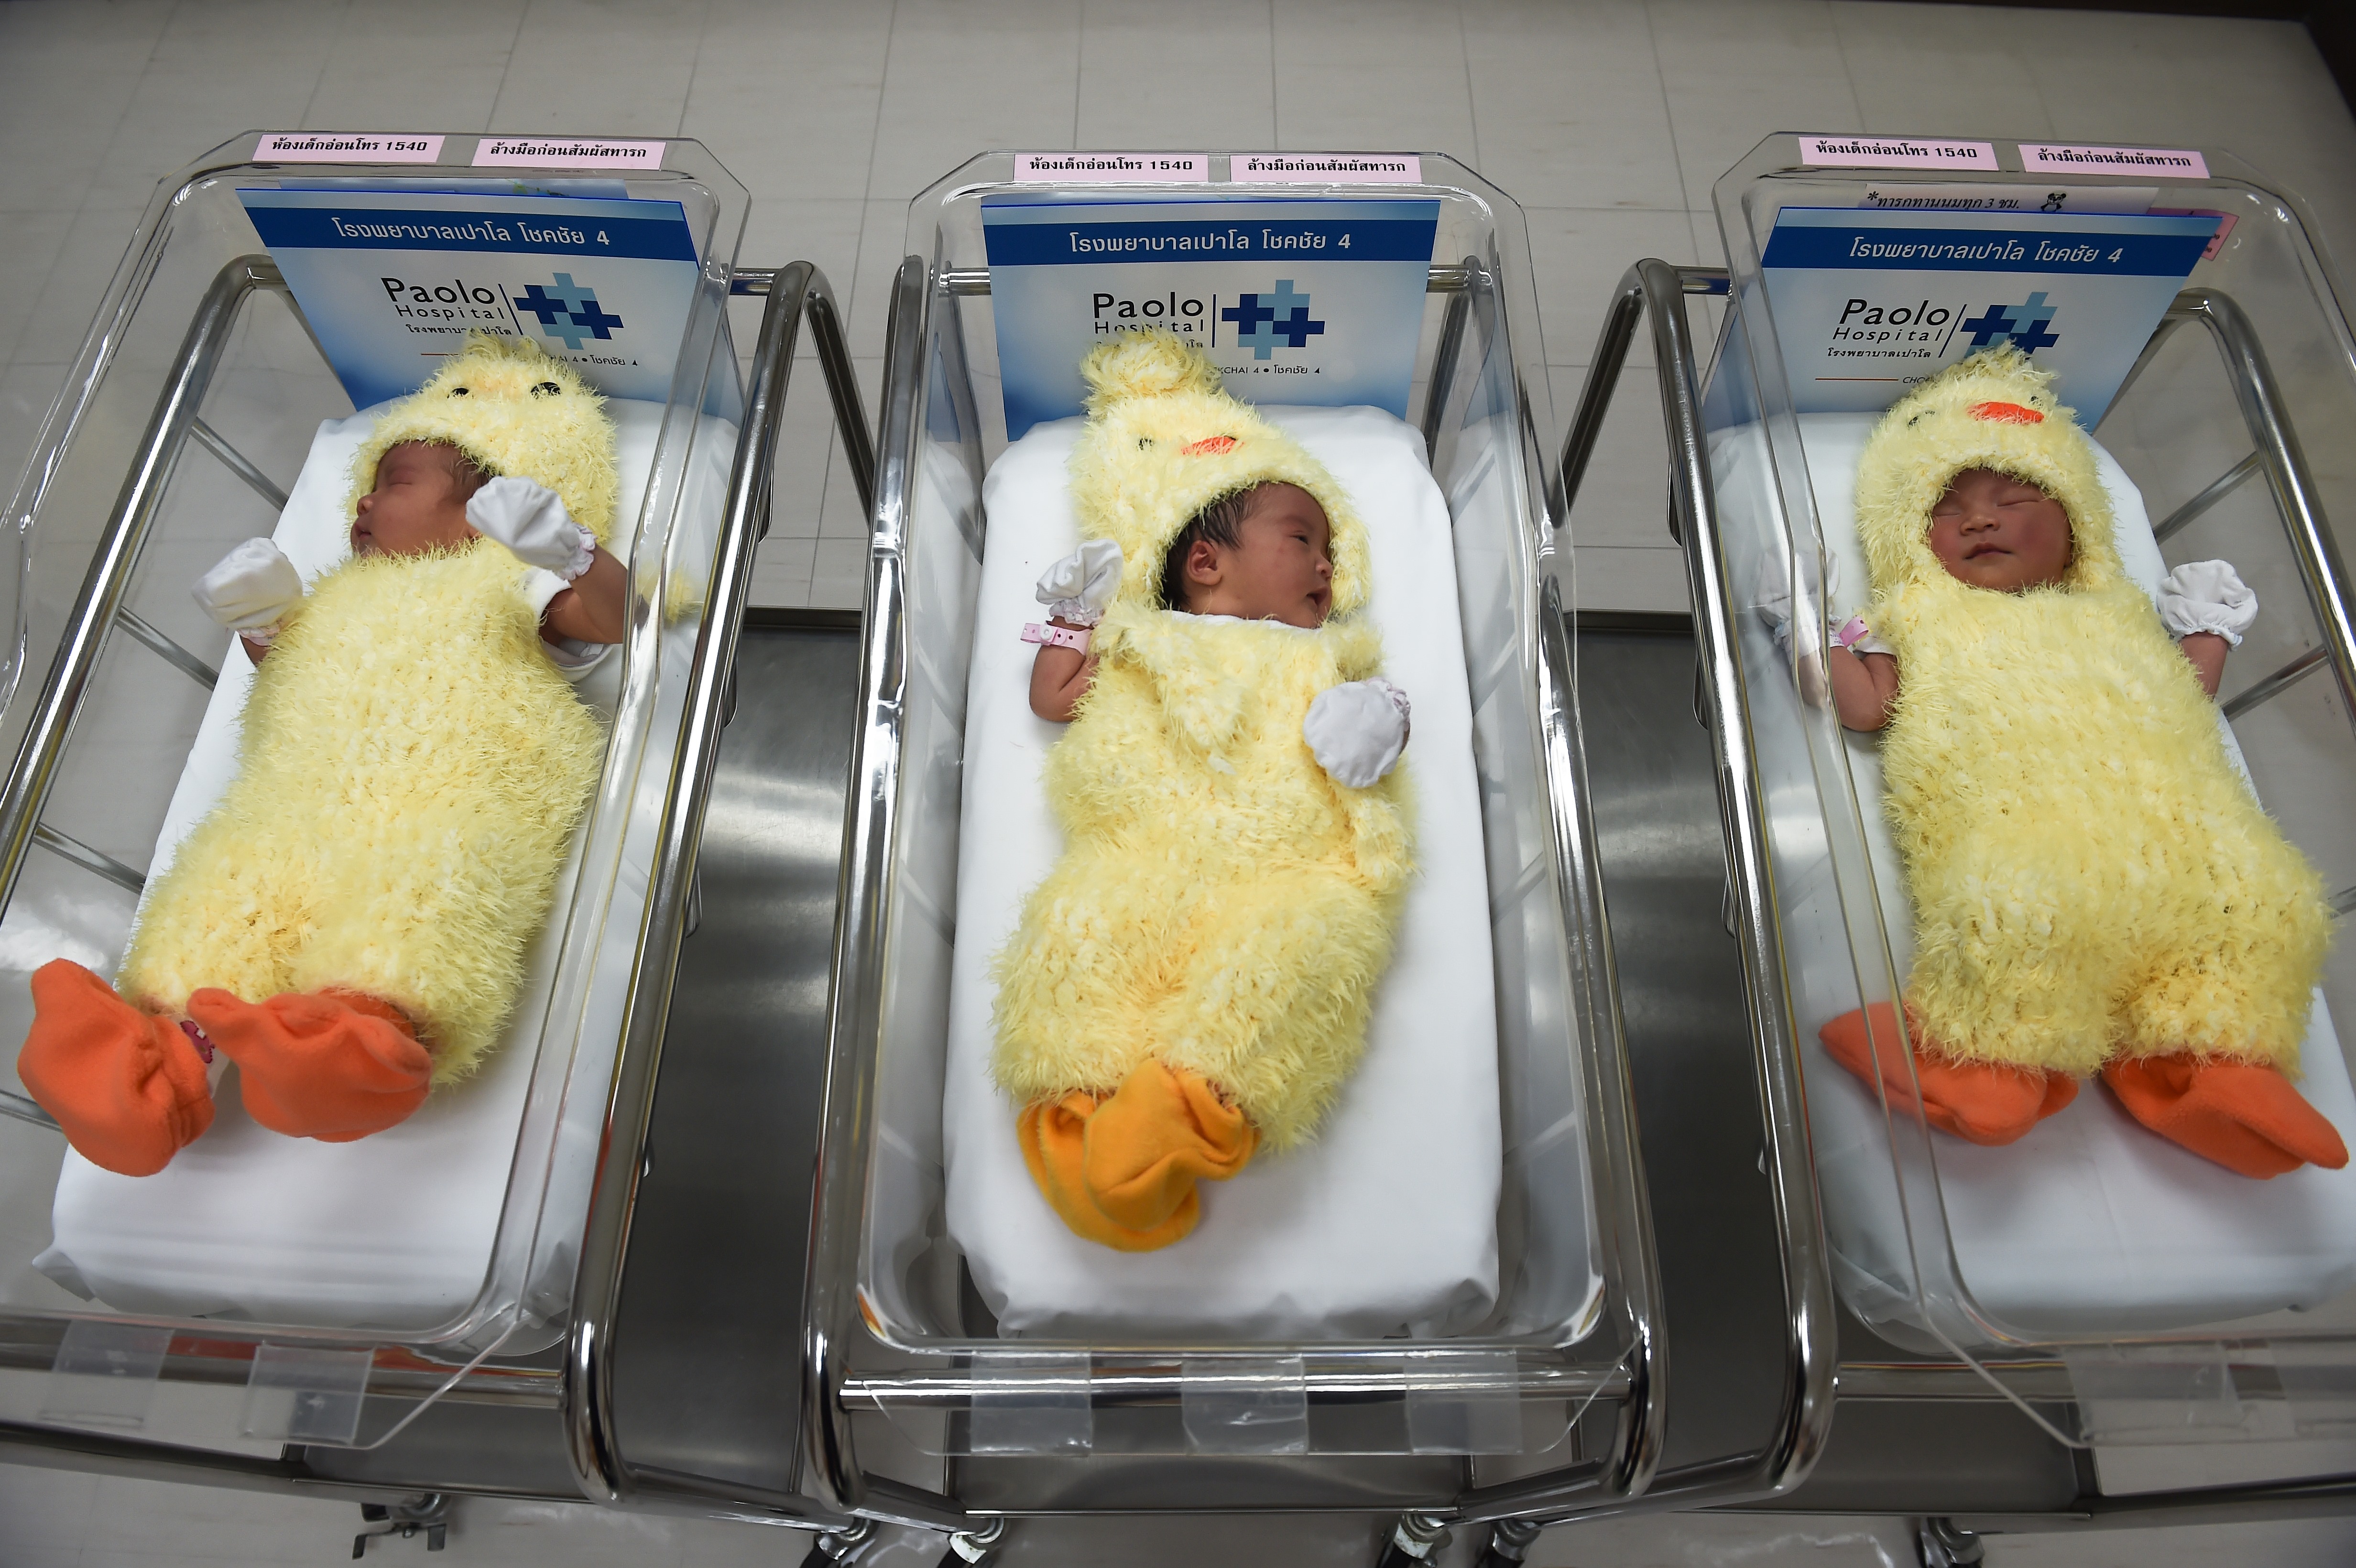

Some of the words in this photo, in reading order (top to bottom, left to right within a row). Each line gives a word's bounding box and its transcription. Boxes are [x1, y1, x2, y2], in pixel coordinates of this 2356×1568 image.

[273, 137, 380, 150] ห้องเด็กอ่อนโทร
[387, 142, 428, 151] 1540
[490, 142, 646, 157] ล้างมือก่อนสัมผัสทารก
[1816, 140, 1928, 156] ห้องเด็กอ่อนโทร
[1935, 148, 1977, 158] 1540
[1030, 157, 1143, 170] ห้องเด็กอ่อนโทร
[1150, 161, 1192, 170] 1540
[1247, 158, 1406, 172] ล้างมือก่อนสัมผัสทารก
[2038, 148, 2191, 166] ล้างมือก่อนสัมผัสทารก
[1985, 198, 1994, 208] 3
[1998, 198, 2019, 209] ชม.
[331, 218, 511, 241] โรงพยาบาลเปาโล
[517, 222, 585, 244] โชคชัย
[596, 230, 610, 245] 4
[1069, 229, 1249, 252] โรงพยาบาลเปาโล
[1262, 229, 1326, 249] โชคชัย
[1338, 234, 1351, 249] 4
[1849, 237, 2024, 260] โรงพยาบาลเปาโล
[2034, 241, 2099, 262] โชคชัย
[2107, 248, 2123, 262] 4
[381, 277, 495, 304] Paolo
[395, 305, 504, 321] Hospital
[1093, 292, 1203, 318] Paolo
[1839, 299, 1950, 326] Paolo
[1832, 327, 1942, 344] Hospital
[589, 354, 626, 365] โชคชัย
[1828, 348, 1931, 358] โรงพยาบาลเปาโล
[1274, 364, 1308, 374] โชคชัย
